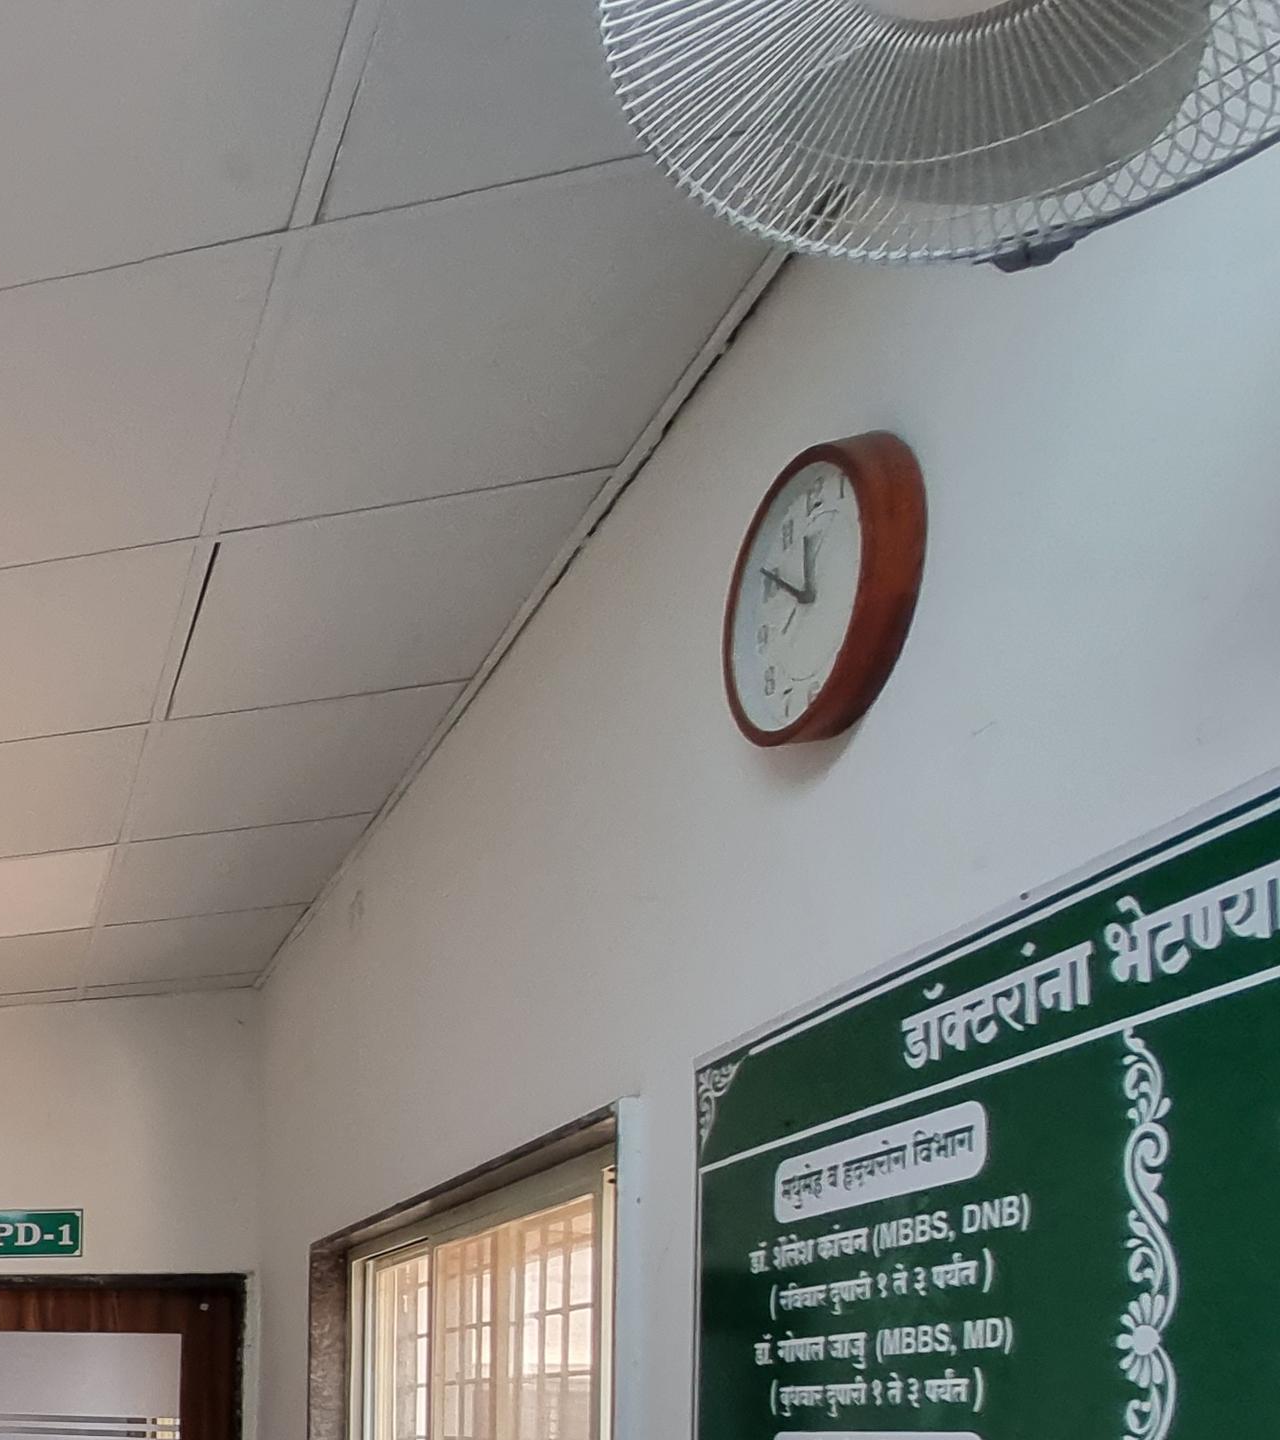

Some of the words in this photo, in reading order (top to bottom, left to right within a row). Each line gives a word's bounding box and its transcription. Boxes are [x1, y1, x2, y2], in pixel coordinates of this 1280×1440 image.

[901, 941, 1094, 1069] डॉक्टरांना
[827, 1163, 838, 1186] व
[913, 1125, 974, 1166] विभाग
[873, 1211, 956, 1257] (MBBS,
[962, 1194, 1031, 1234] DNB)
[876, 1324, 957, 1364] (MBBS,
[963, 1317, 1014, 1354] MD)
